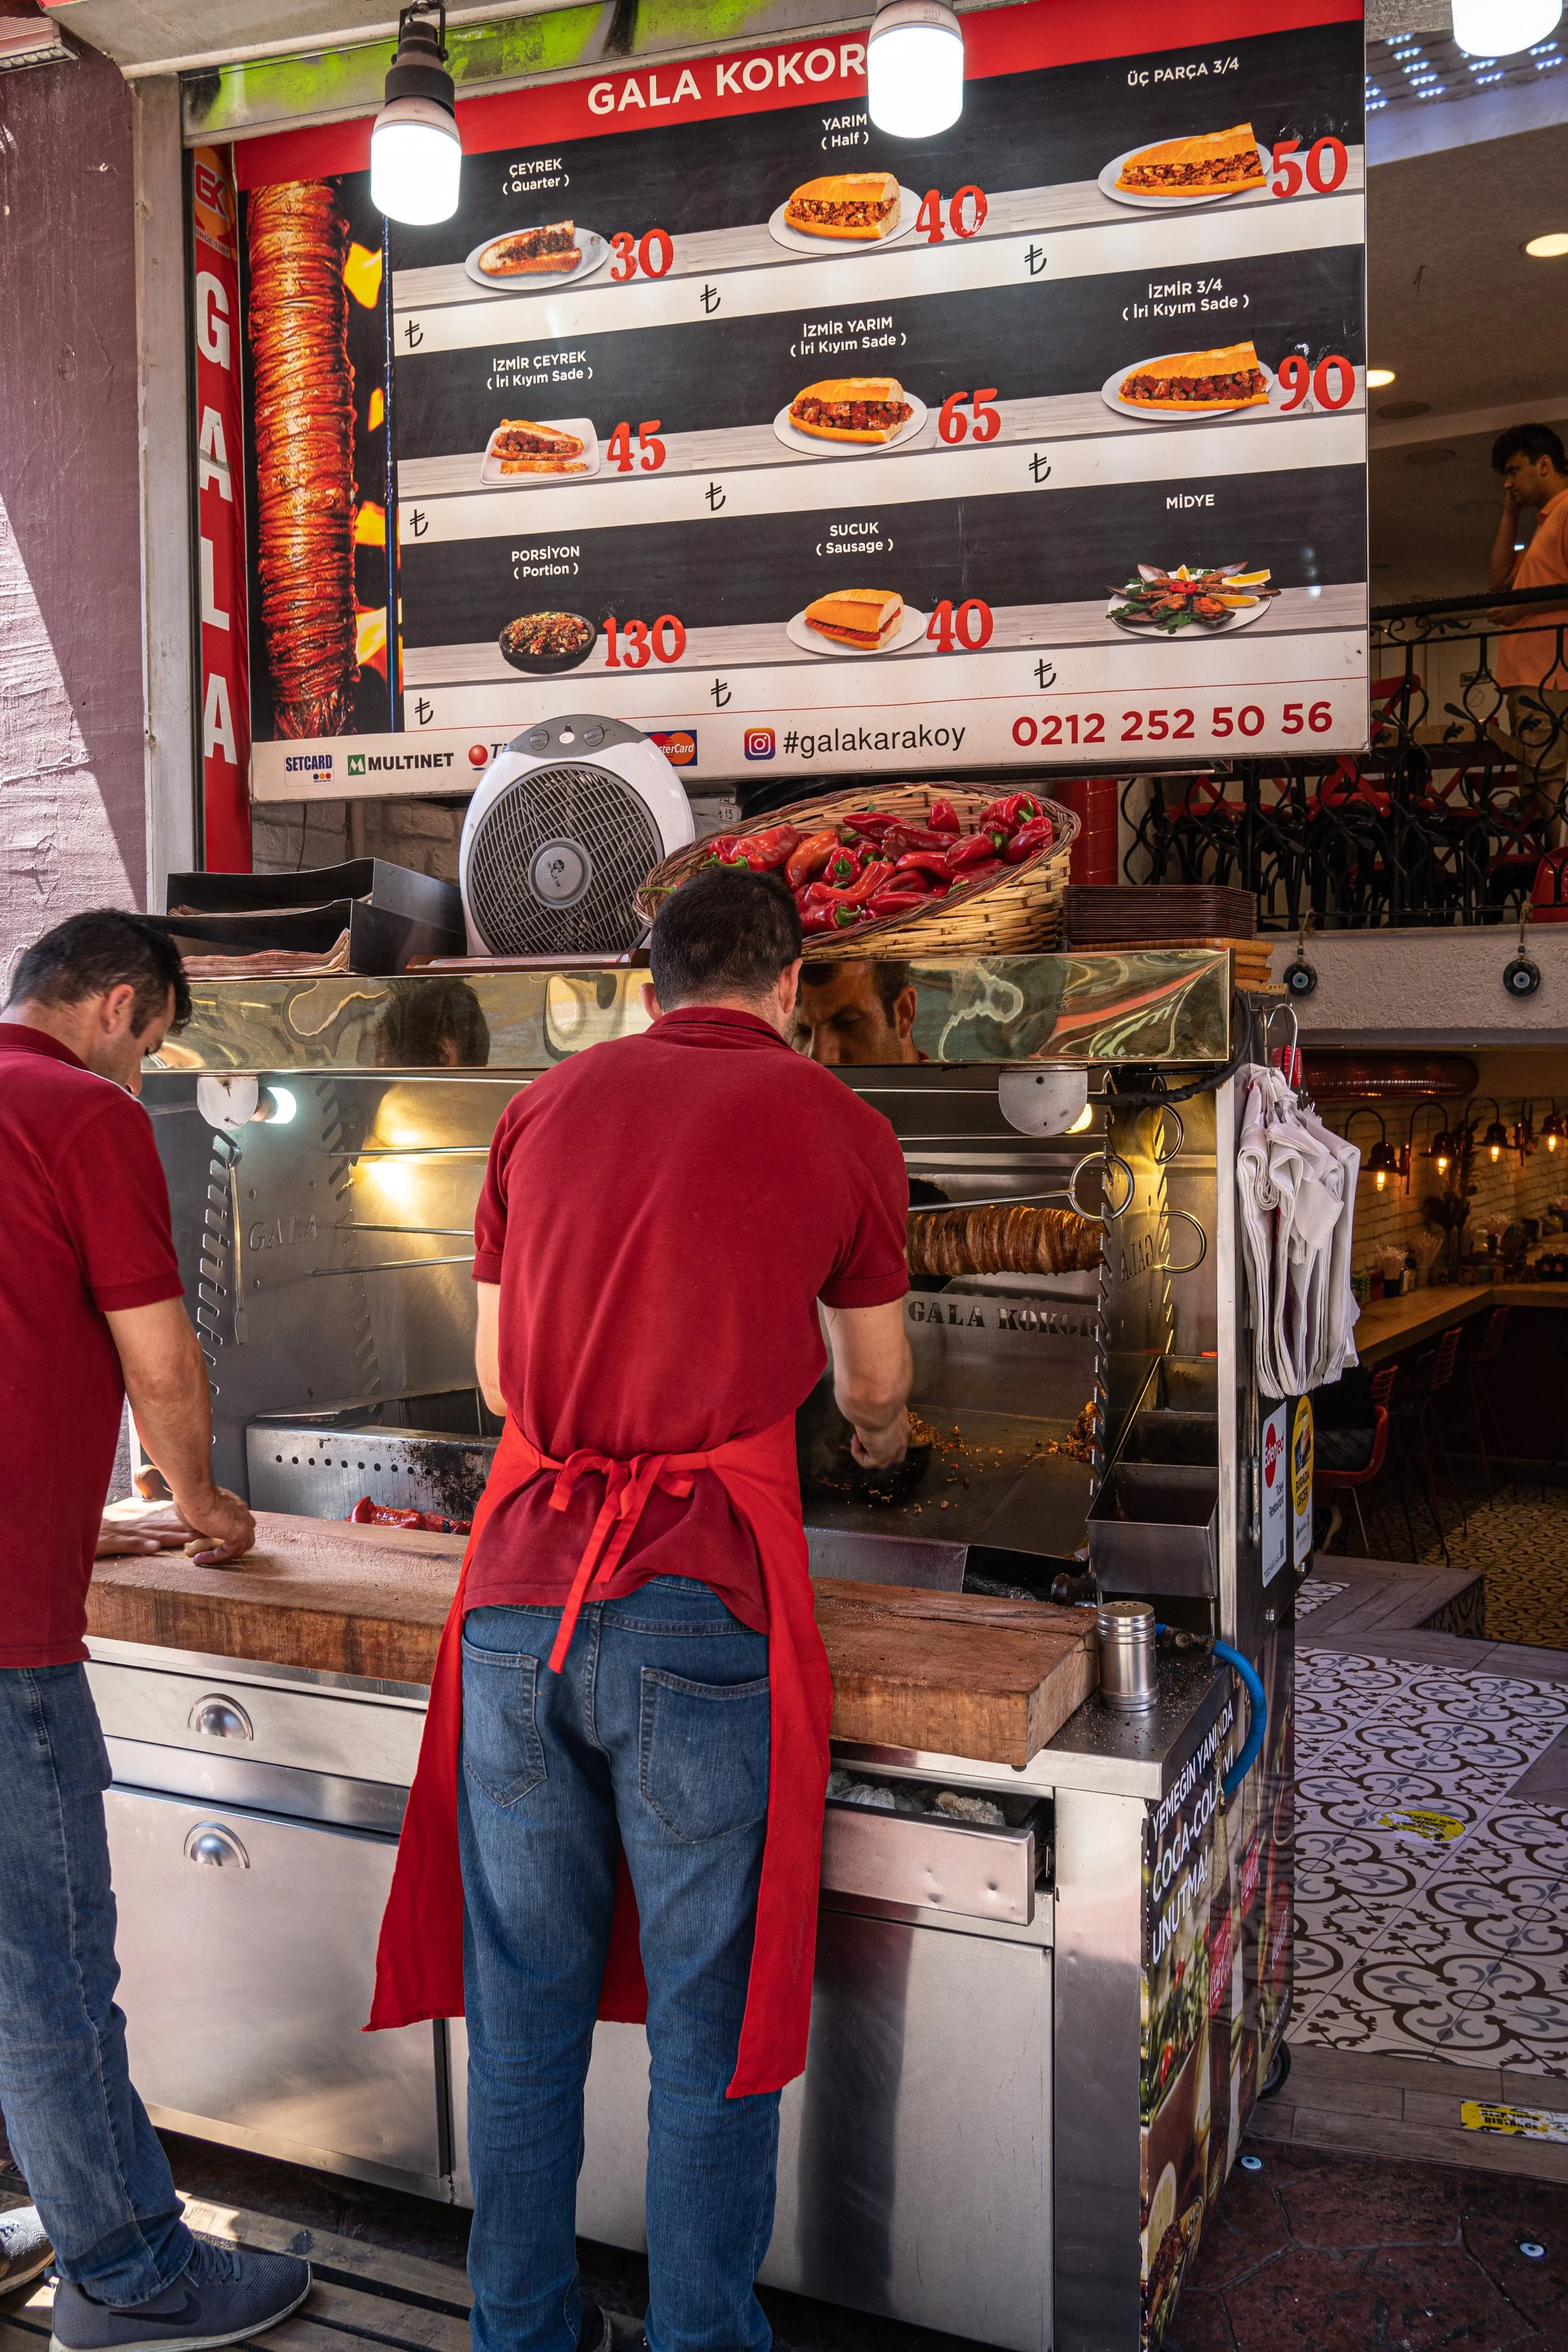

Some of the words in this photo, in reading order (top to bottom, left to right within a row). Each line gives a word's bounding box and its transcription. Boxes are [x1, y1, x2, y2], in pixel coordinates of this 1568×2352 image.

[588, 70, 702, 115] GALA
[716, 43, 866, 97] KOKOR
[1127, 71, 1149, 87] ÜÇ
[1154, 63, 1209, 83] PARÇA
[1213, 57, 1239, 77] 3/4
[822, 113, 867, 132] YARIM
[509, 158, 562, 177] ÇEYREK
[1271, 136, 1348, 198] 50
[915, 184, 988, 243] 40
[195, 226, 213, 246] INCE
[610, 228, 674, 282] 30
[1148, 281, 1192, 299] İZMİR
[1197, 278, 1222, 295] 3/4
[1153, 302, 1195, 318] Kıyım
[803, 320, 843, 337] İZMİR
[847, 316, 893, 334] YARIM
[818, 339, 857, 354] Kıyım
[492, 356, 529, 372] İZMİR
[533, 351, 586, 369] ÇEYREK
[512, 373, 548, 388] Kıyım
[1278, 355, 1355, 411] 90
[938, 388, 1001, 444] 65
[607, 419, 666, 472] 45
[1166, 493, 1215, 509] MİDYE
[196, 270, 238, 764] GALA
[829, 521, 879, 537] SUCUK
[511, 545, 580, 563] PORSİYON
[926, 598, 993, 652] 40
[603, 614, 686, 669] 130
[1012, 712, 1105, 746] 0212
[1121, 708, 1195, 741] 252
[1210, 705, 1265, 738] 50
[1281, 701, 1333, 734] 56
[659, 743, 694, 754] sterCard
[783, 724, 966, 759] #galakarakoy
[286, 755, 332, 772] SETCARD
[368, 753, 454, 771] MULTINET
[248, 1213, 319, 1252] GALA
[908, 1301, 985, 1328] GALA
[1264, 1430, 1284, 1468] Edenred
[1296, 1468, 1310, 1494] BURADA
[1153, 1756, 1196, 1841] YEMEĞİN
[1152, 1845, 1209, 1965] UNUTMA!
